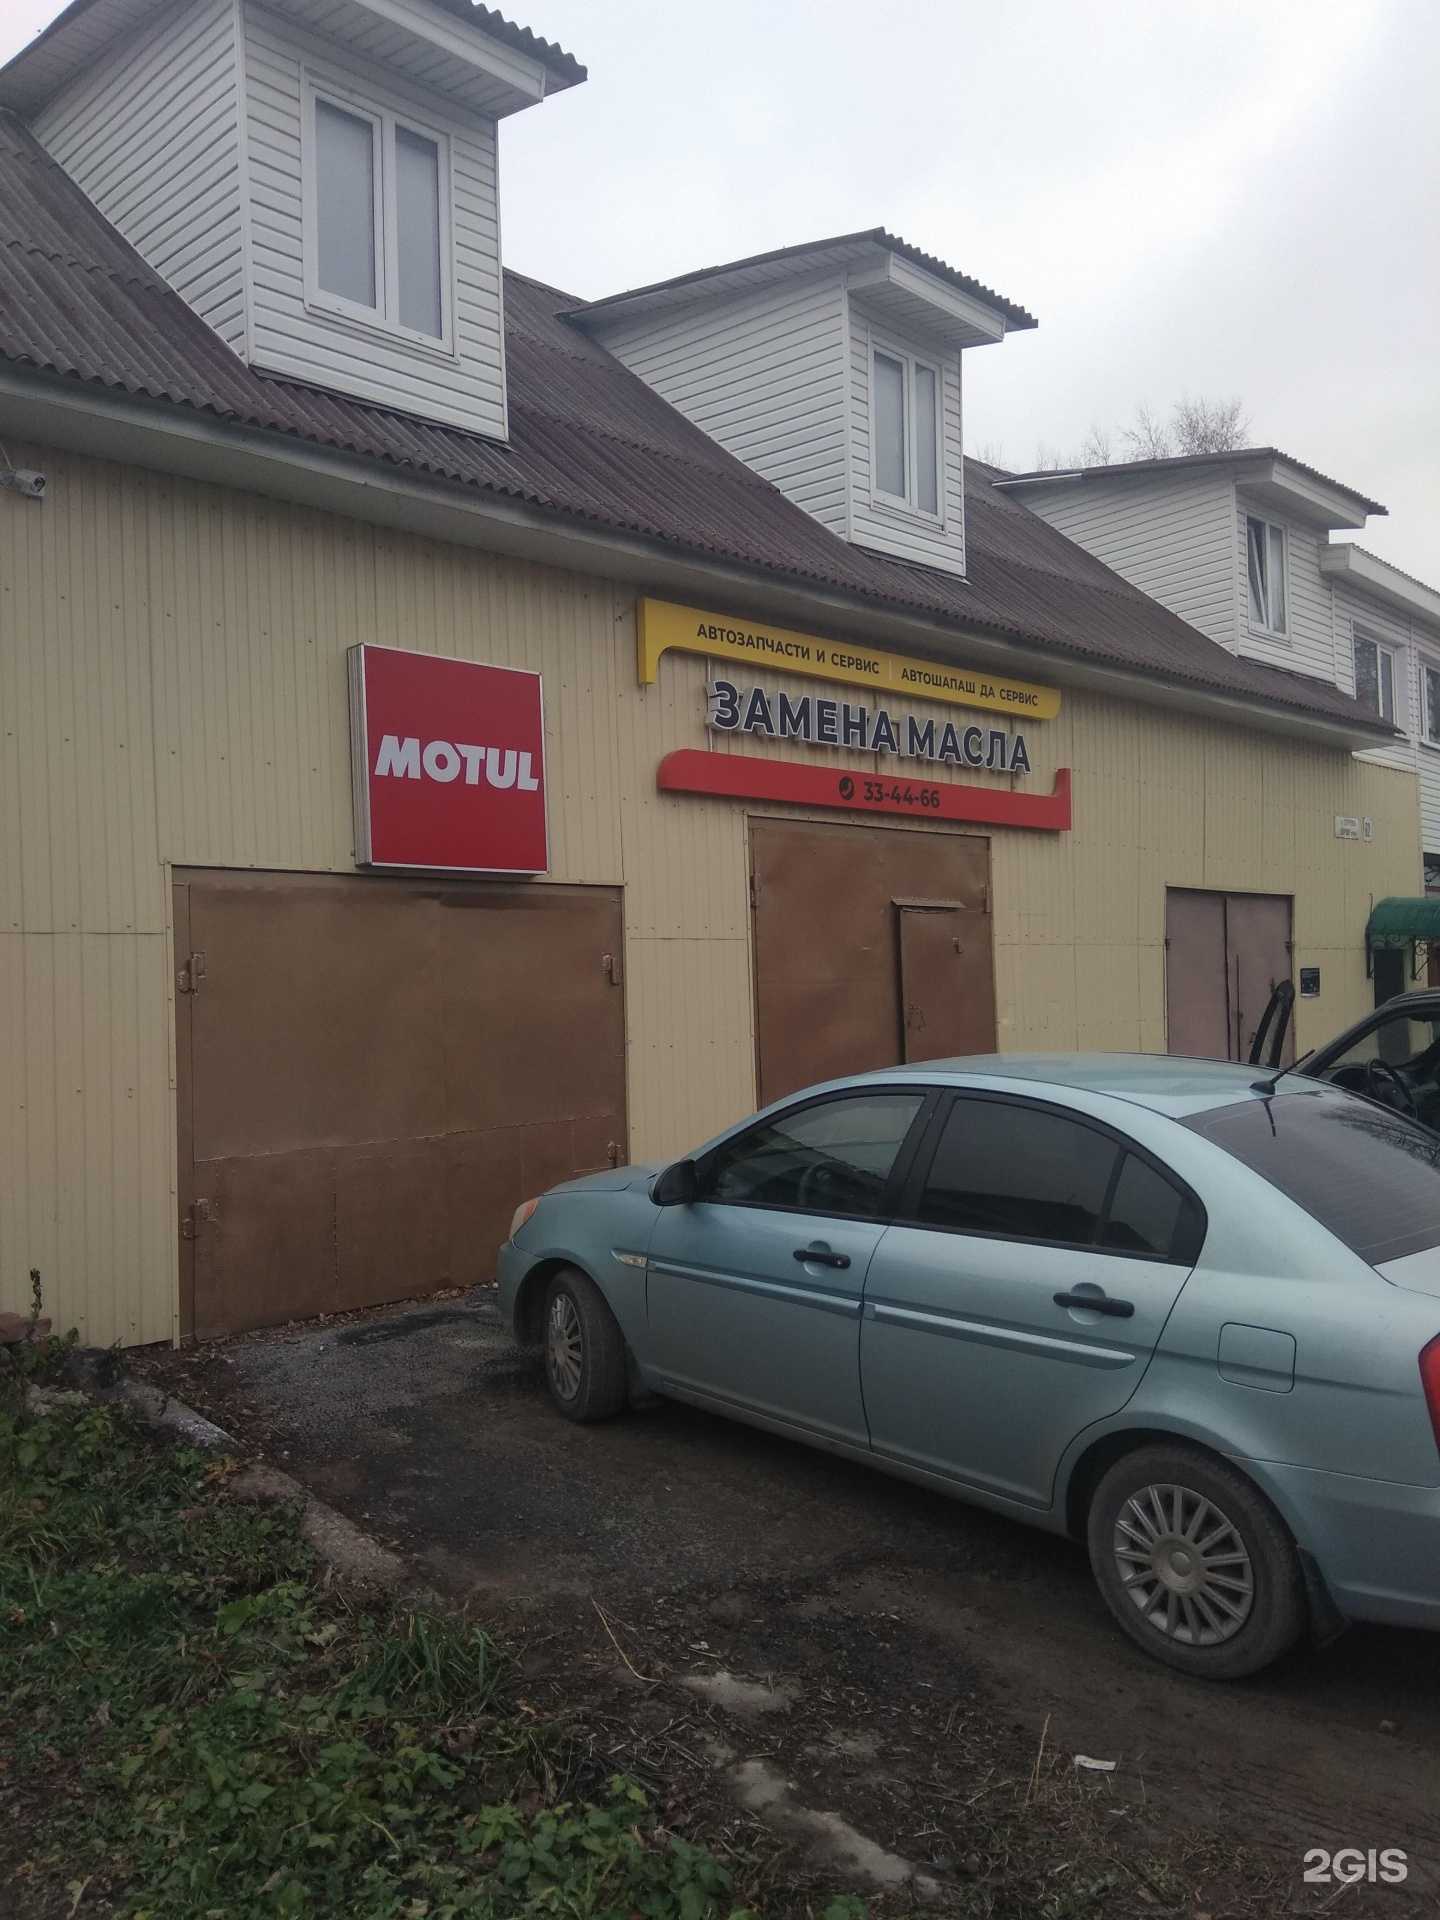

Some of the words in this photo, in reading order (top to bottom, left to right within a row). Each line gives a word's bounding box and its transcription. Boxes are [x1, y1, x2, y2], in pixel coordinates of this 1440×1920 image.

[697, 623, 810, 661] АВТОЗАПЧАСТИ
[816, 649, 826, 663] И
[831, 652, 880, 675] СЕРВИС
[901, 668, 976, 694] АВТОШАПАШ
[979, 684, 996, 699] ДА
[999, 688, 1039, 707] СЕРВИС
[708, 680, 898, 754] ЗАМЕНА
[907, 714, 1032, 775] МАСЛА
[374, 735, 539, 791] MOTUL
[863, 781, 941, 809] 33-44-66
